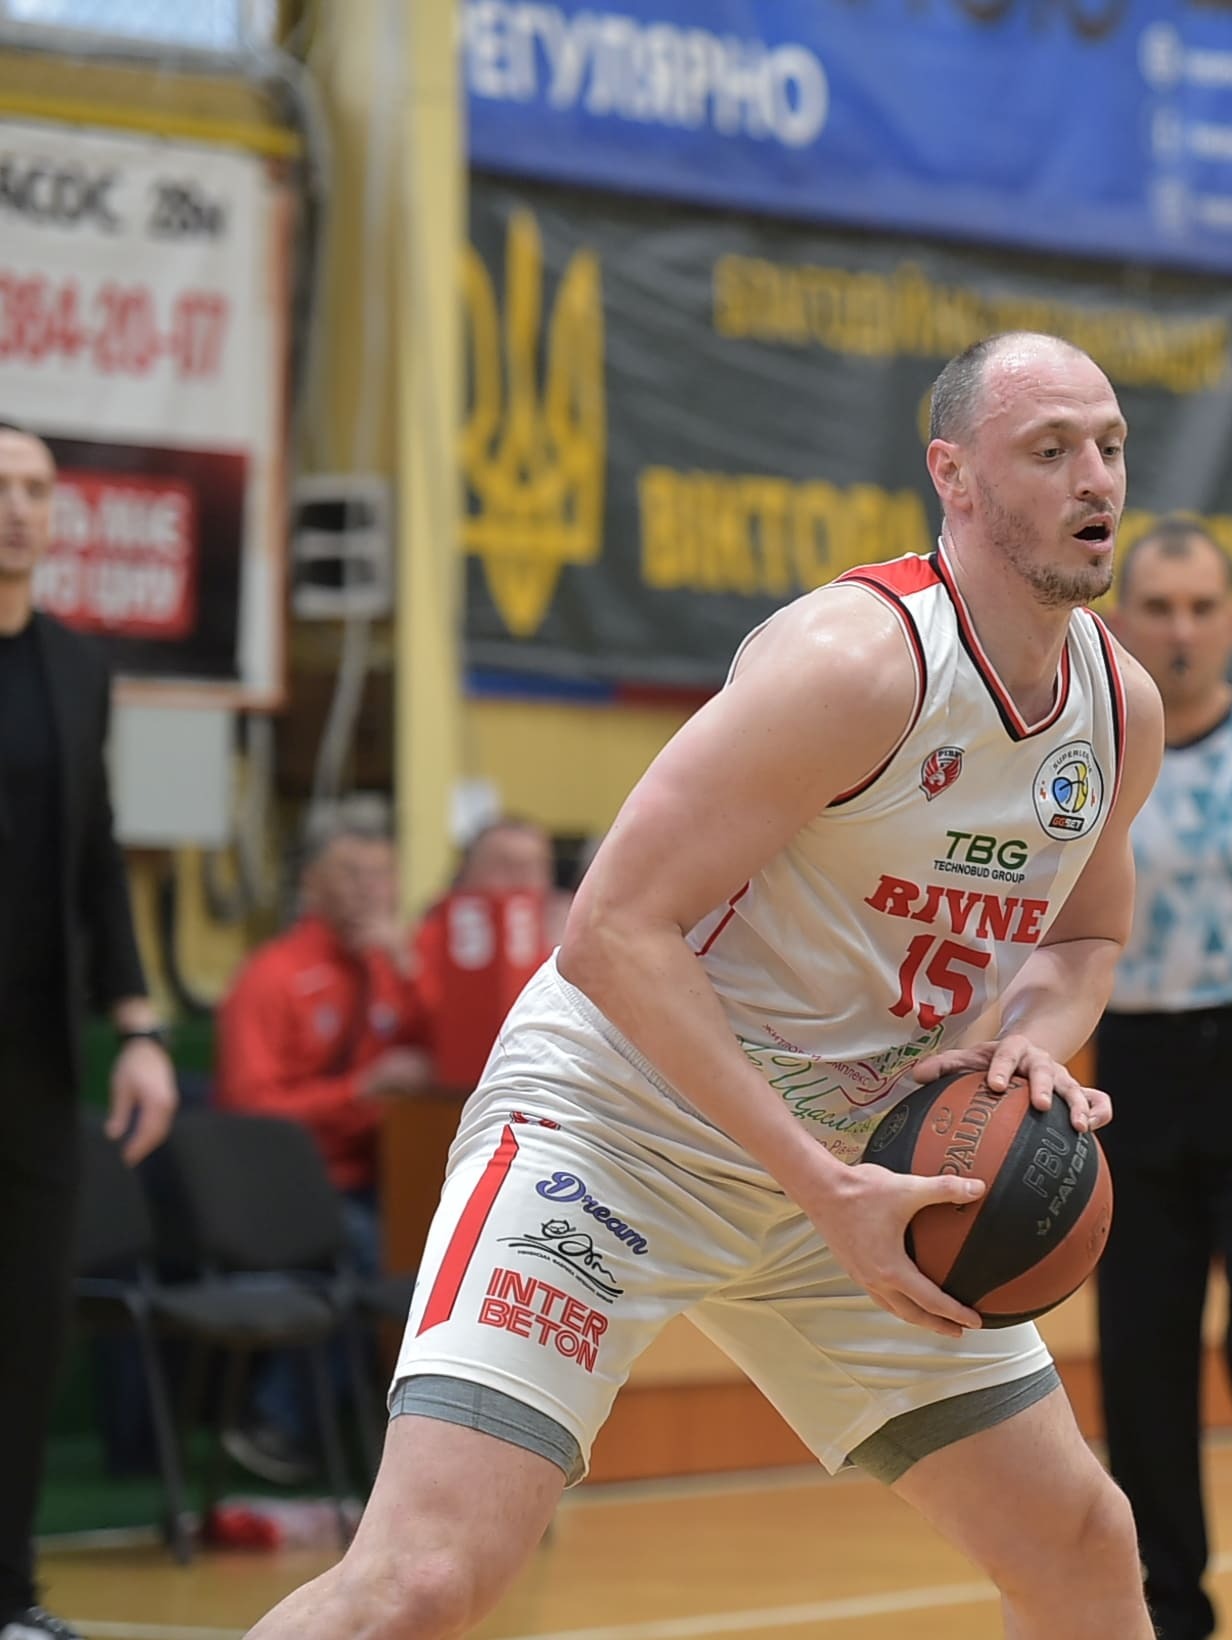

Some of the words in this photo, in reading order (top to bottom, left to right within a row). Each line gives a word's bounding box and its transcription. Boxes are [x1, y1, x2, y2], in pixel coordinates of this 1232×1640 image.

[468, 0, 829, 148] ЕГУЛЯРНО
[933, 859, 990, 878] TECHNOBUD
[991, 869, 1025, 884] GROUP
[946, 830, 1029, 870] TBG
[864, 874, 1050, 944] RIVNE
[887, 934, 992, 1031] 15
[1022, 1126, 1071, 1198] FBU
[535, 1171, 649, 1256] Dream
[477, 1297, 600, 1374] BETON
[486, 1267, 609, 1347] INTER
